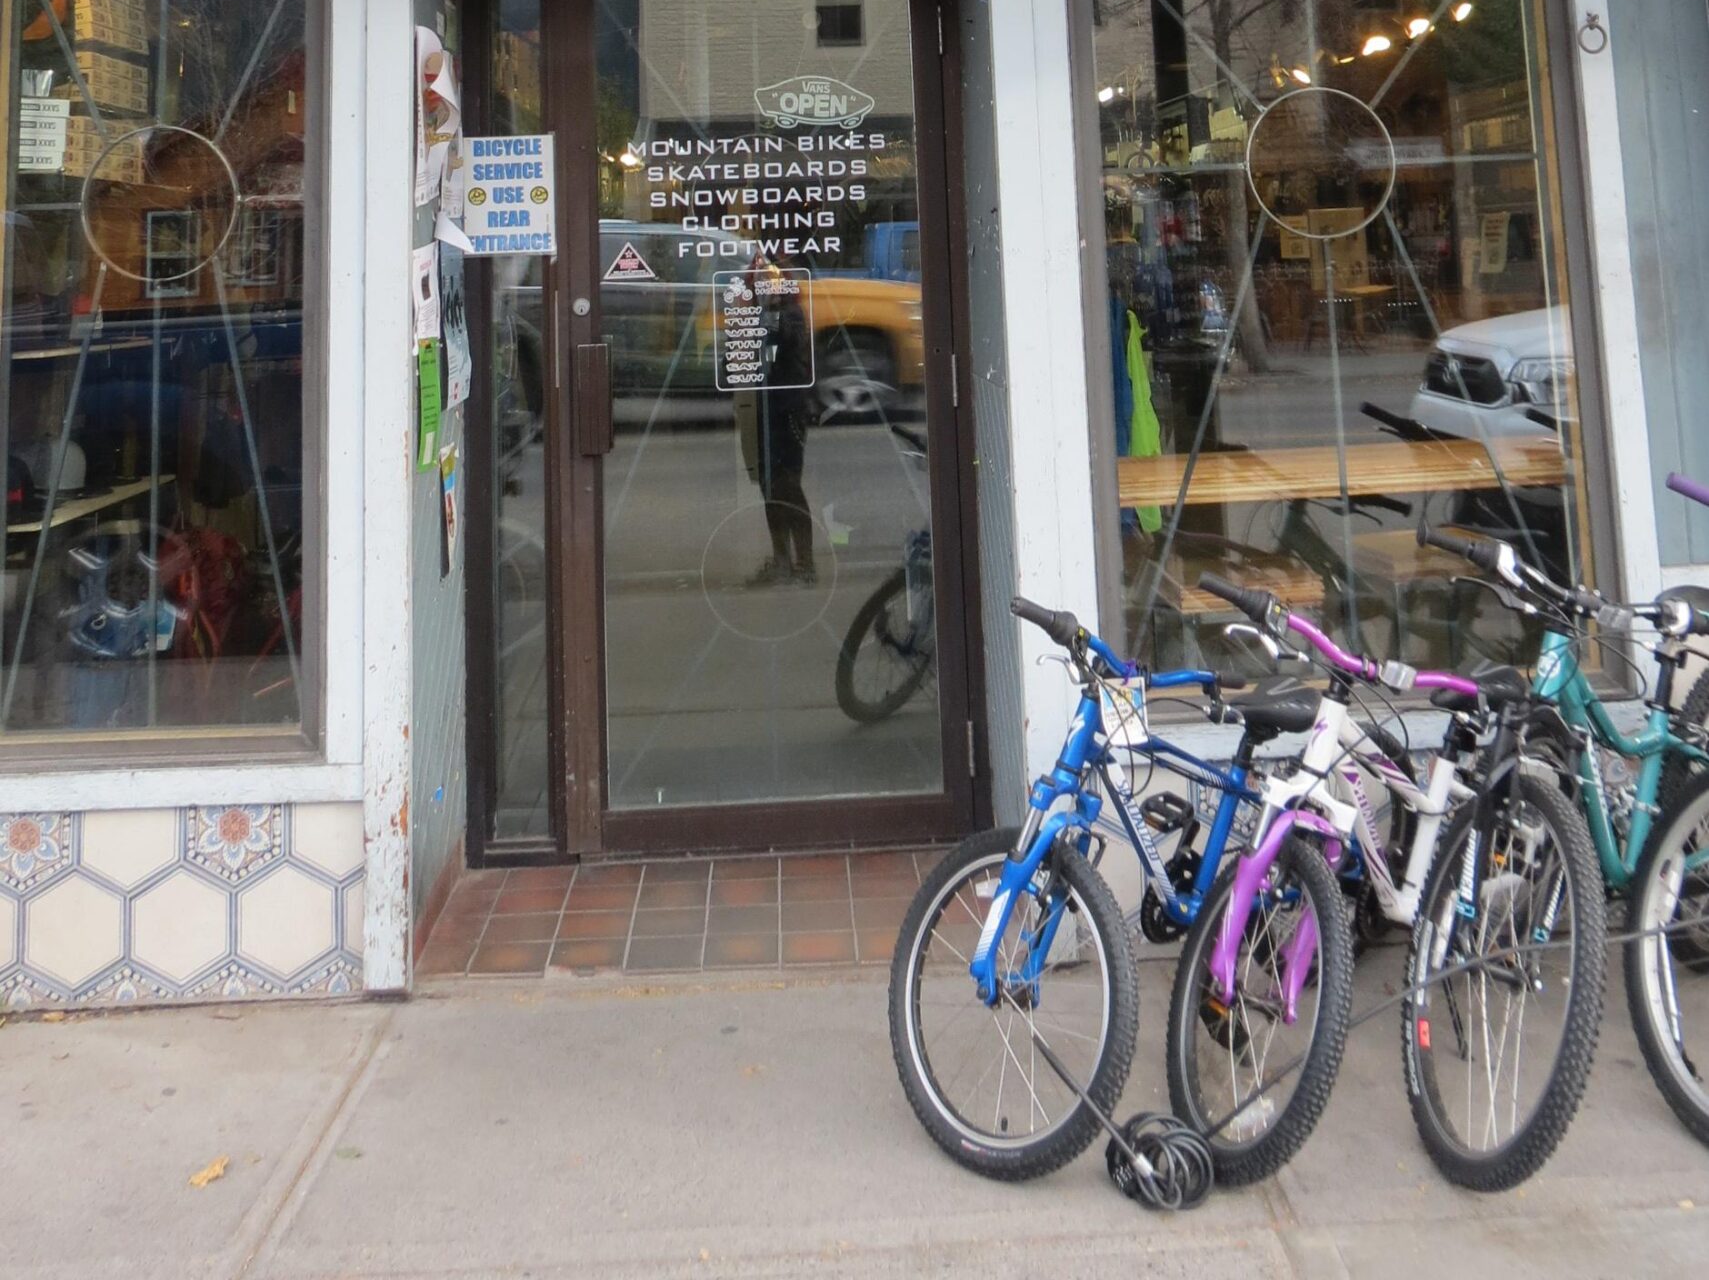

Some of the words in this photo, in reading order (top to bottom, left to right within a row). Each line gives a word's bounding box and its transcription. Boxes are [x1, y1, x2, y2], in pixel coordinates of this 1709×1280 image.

[801, 81, 831, 93] VANS
[473, 138, 541, 157] BICYCLE
[627, 137, 783, 157] MOUNTAIN
[798, 133, 885, 152] BIKES
[473, 162, 543, 181] SERVICE
[647, 159, 867, 182] SKATEBOARDS
[493, 186, 525, 204] USE
[650, 185, 866, 208] SNOWBOARDS
[488, 210, 530, 228] REAR
[682, 211, 835, 233] CLOTHING
[678, 237, 841, 258] FOOTWEAR
[724, 307, 762, 315] MON
[724, 317, 760, 326] TUE
[725, 328, 767, 337] WED
[725, 340, 762, 349] THU
[725, 351, 755, 360] FRI
[726, 362, 762, 372] SAT
[727, 374, 764, 384] SUN
